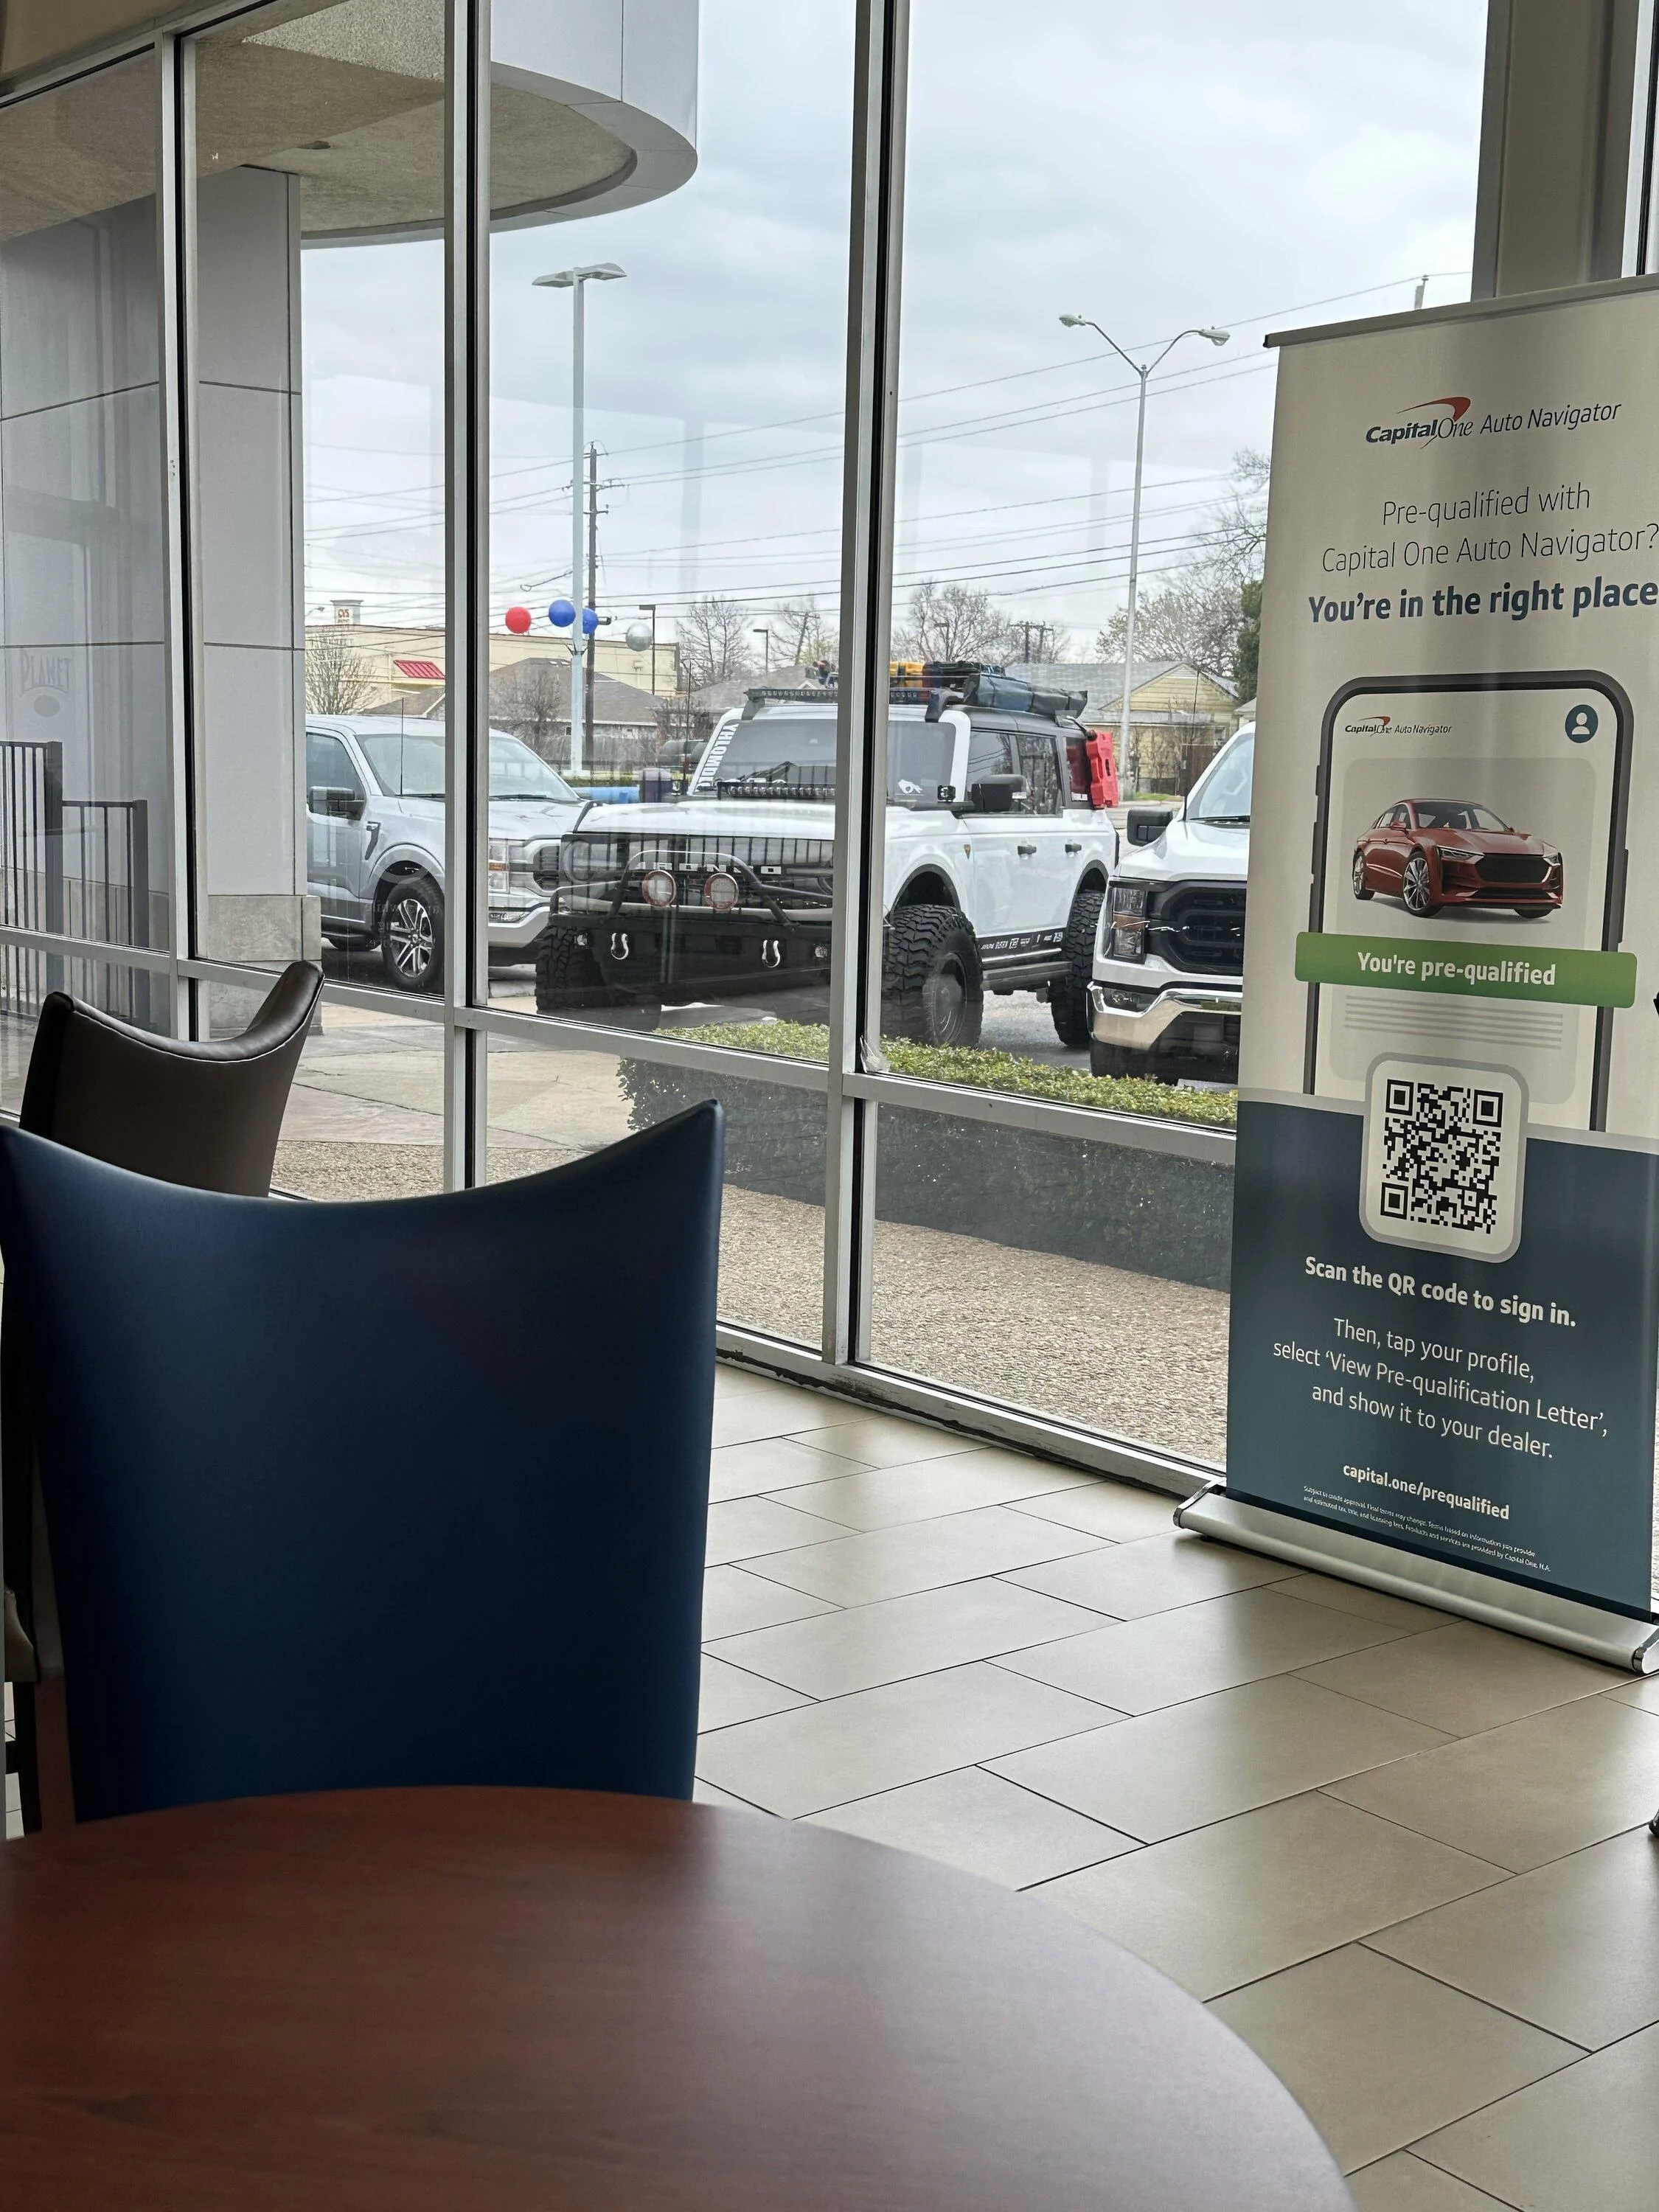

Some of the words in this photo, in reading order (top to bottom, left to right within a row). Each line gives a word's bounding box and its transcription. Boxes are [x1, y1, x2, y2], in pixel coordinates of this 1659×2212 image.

[1479, 414, 1523, 435] Auto
[1527, 403, 1622, 431] Navigator
[1382, 487, 1530, 528] Pre-qualified
[1538, 481, 1590, 512] with
[1322, 541, 1396, 577] Capital
[1404, 540, 1449, 567] One
[1455, 537, 1511, 563] Auto
[1520, 523, 1659, 562] Navigator?
[1308, 591, 1391, 623] You’re
[1399, 588, 1424, 619] in
[1432, 585, 1481, 617] the
[1489, 580, 1565, 622] right
[1572, 576, 1659, 618] place
[1357, 951, 1416, 975] You're
[1421, 960, 1557, 986] pre-qualified
[1305, 1256, 1347, 1282] Scan
[1351, 1265, 1383, 1289] the
[1388, 1272, 1416, 1297] QR
[1421, 1281, 1469, 1306] code
[1472, 1290, 1495, 1311] to
[1500, 1295, 1544, 1324] sign
[1549, 1302, 1576, 1327] in.
[1273, 1340, 1321, 1367] select
[1325, 1350, 1371, 1378] ‘View
[1376, 1361, 1531, 1416] Pre-qualification
[1333, 1317, 1381, 1350] Then,
[1385, 1330, 1416, 1357] tap
[1420, 1340, 1464, 1363] your
[1467, 1351, 1534, 1384] profile,
[1311, 1385, 1343, 1407] and
[1348, 1391, 1395, 1419] show
[1399, 1402, 1413, 1425] it
[1416, 1408, 1436, 1429] to
[1440, 1417, 1484, 1440] your
[1487, 1424, 1553, 1458] dealer.
[1342, 1464, 1509, 1520] capital.one/prequalified
